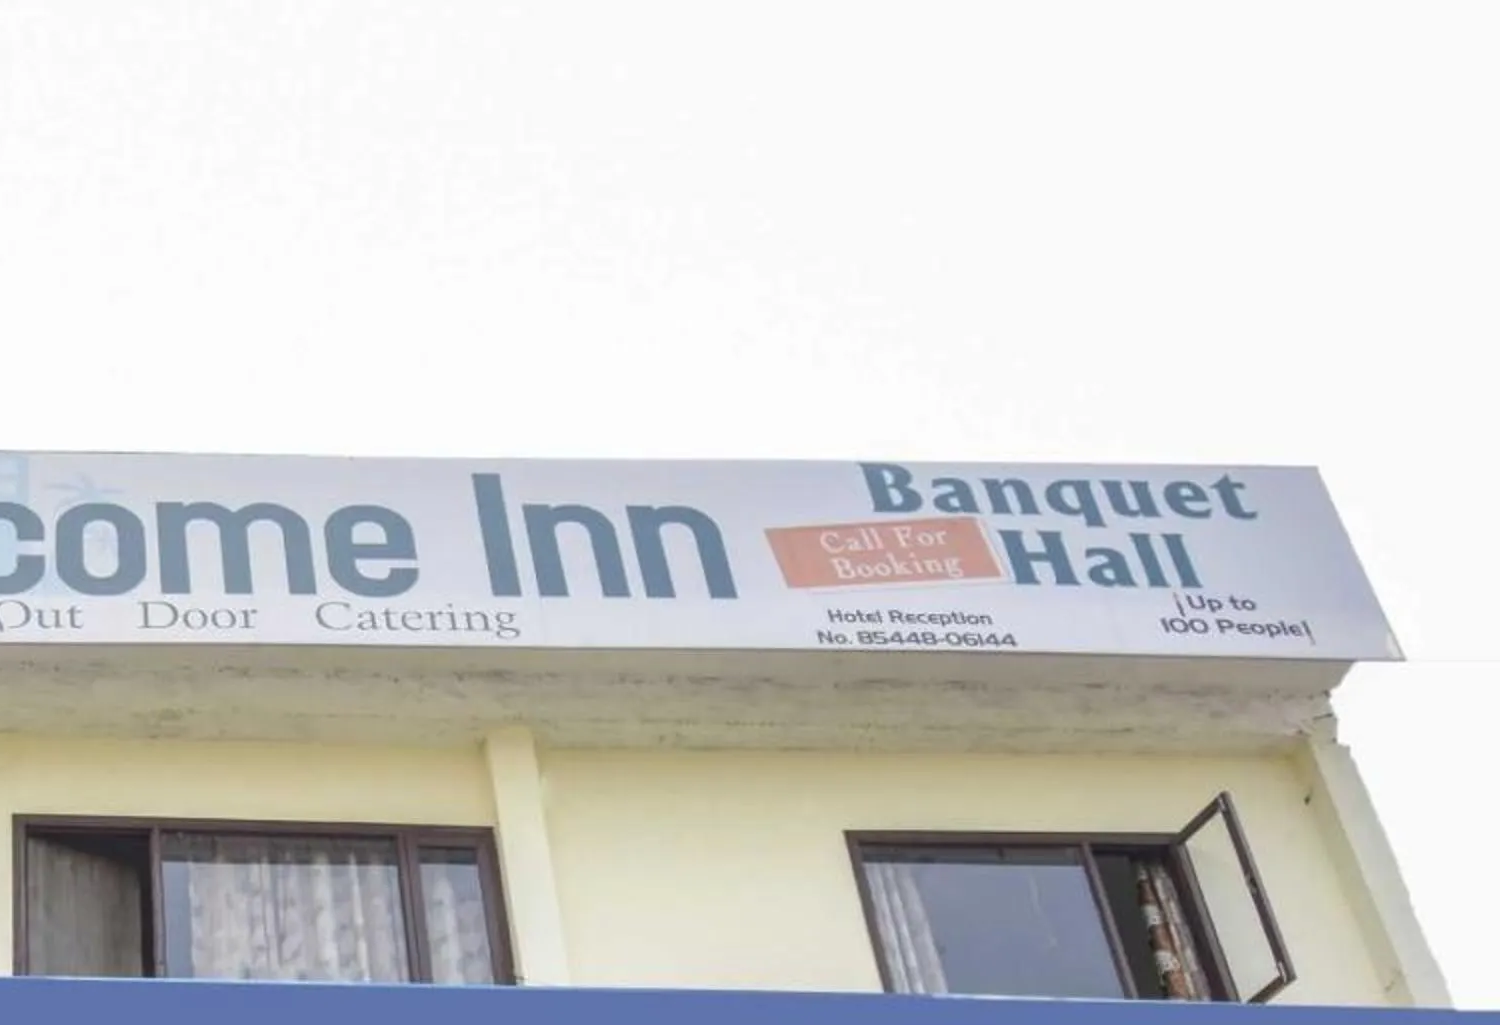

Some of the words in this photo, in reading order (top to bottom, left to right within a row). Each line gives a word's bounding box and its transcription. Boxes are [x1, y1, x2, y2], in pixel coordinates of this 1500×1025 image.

[857, 462, 1257, 528] Banquet
[471, 473, 738, 599] Inn
[819, 528, 884, 553] Call
[892, 526, 948, 547] For
[831, 553, 964, 579] Booking
[998, 529, 1203, 588] Hall
[1229, 595, 1257, 611] to
[138, 600, 258, 630] Door
[315, 601, 520, 638] Catering
[827, 608, 883, 624] Hotel
[888, 609, 994, 627] Reception
[1160, 617, 1209, 634] 100
